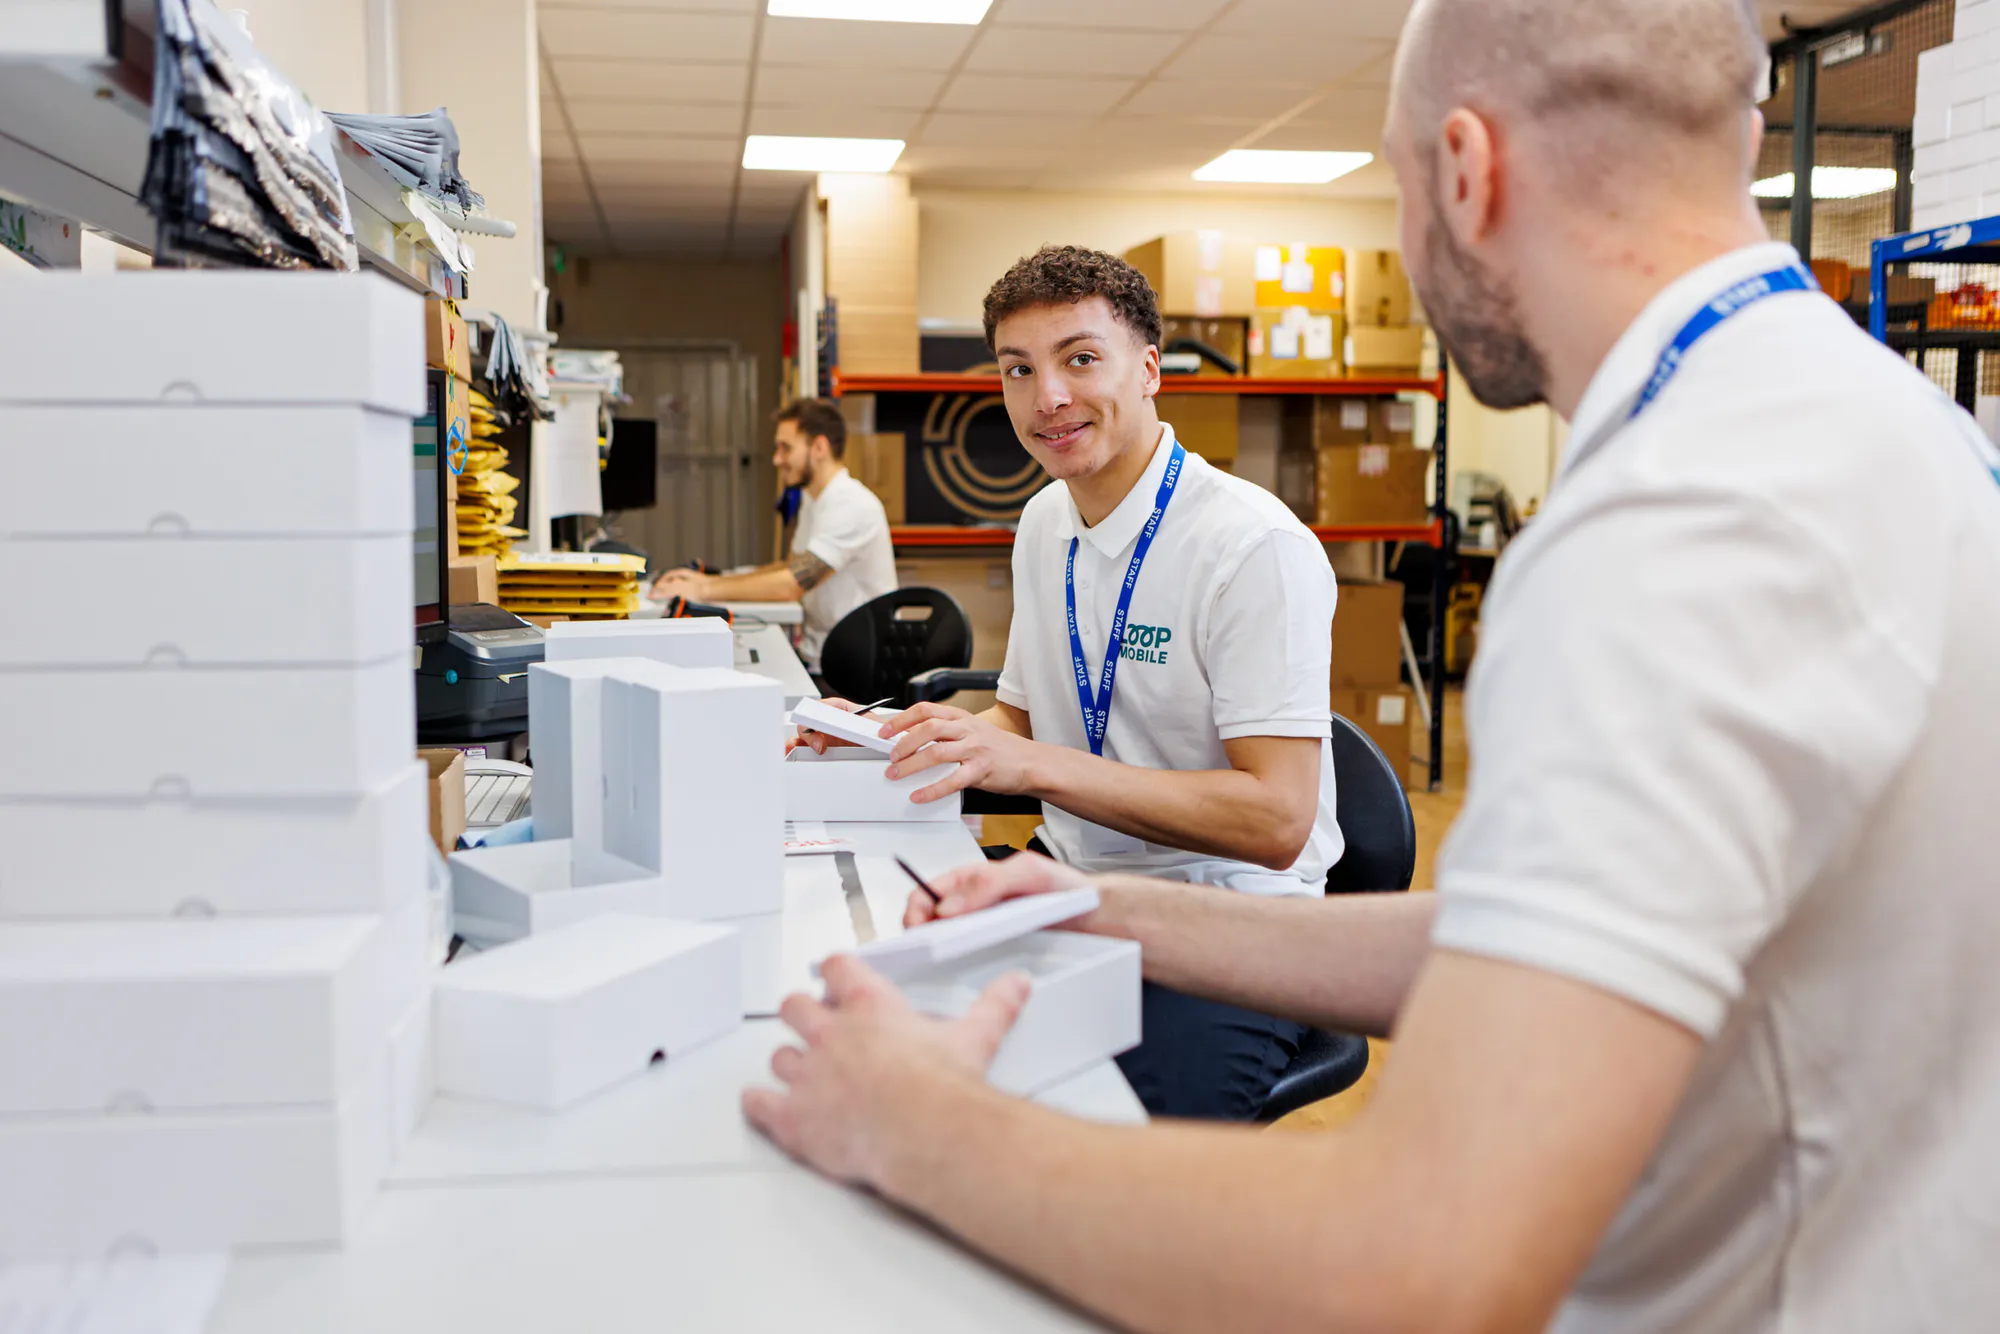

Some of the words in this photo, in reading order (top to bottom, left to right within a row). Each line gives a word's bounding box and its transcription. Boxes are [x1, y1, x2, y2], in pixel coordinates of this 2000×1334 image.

[1164, 458, 1180, 489] STAFF
[1144, 507, 1162, 539] STAFF
[1126, 557, 1140, 589] STAFF
[1067, 605, 1077, 636] STAFF
[1112, 608, 1125, 641] STAFF
[1119, 645, 1168, 665] MOBILE
[1075, 656, 1087, 687] STAFF
[1102, 660, 1114, 692] STAFF
[1094, 709, 1106, 740] STAFF
